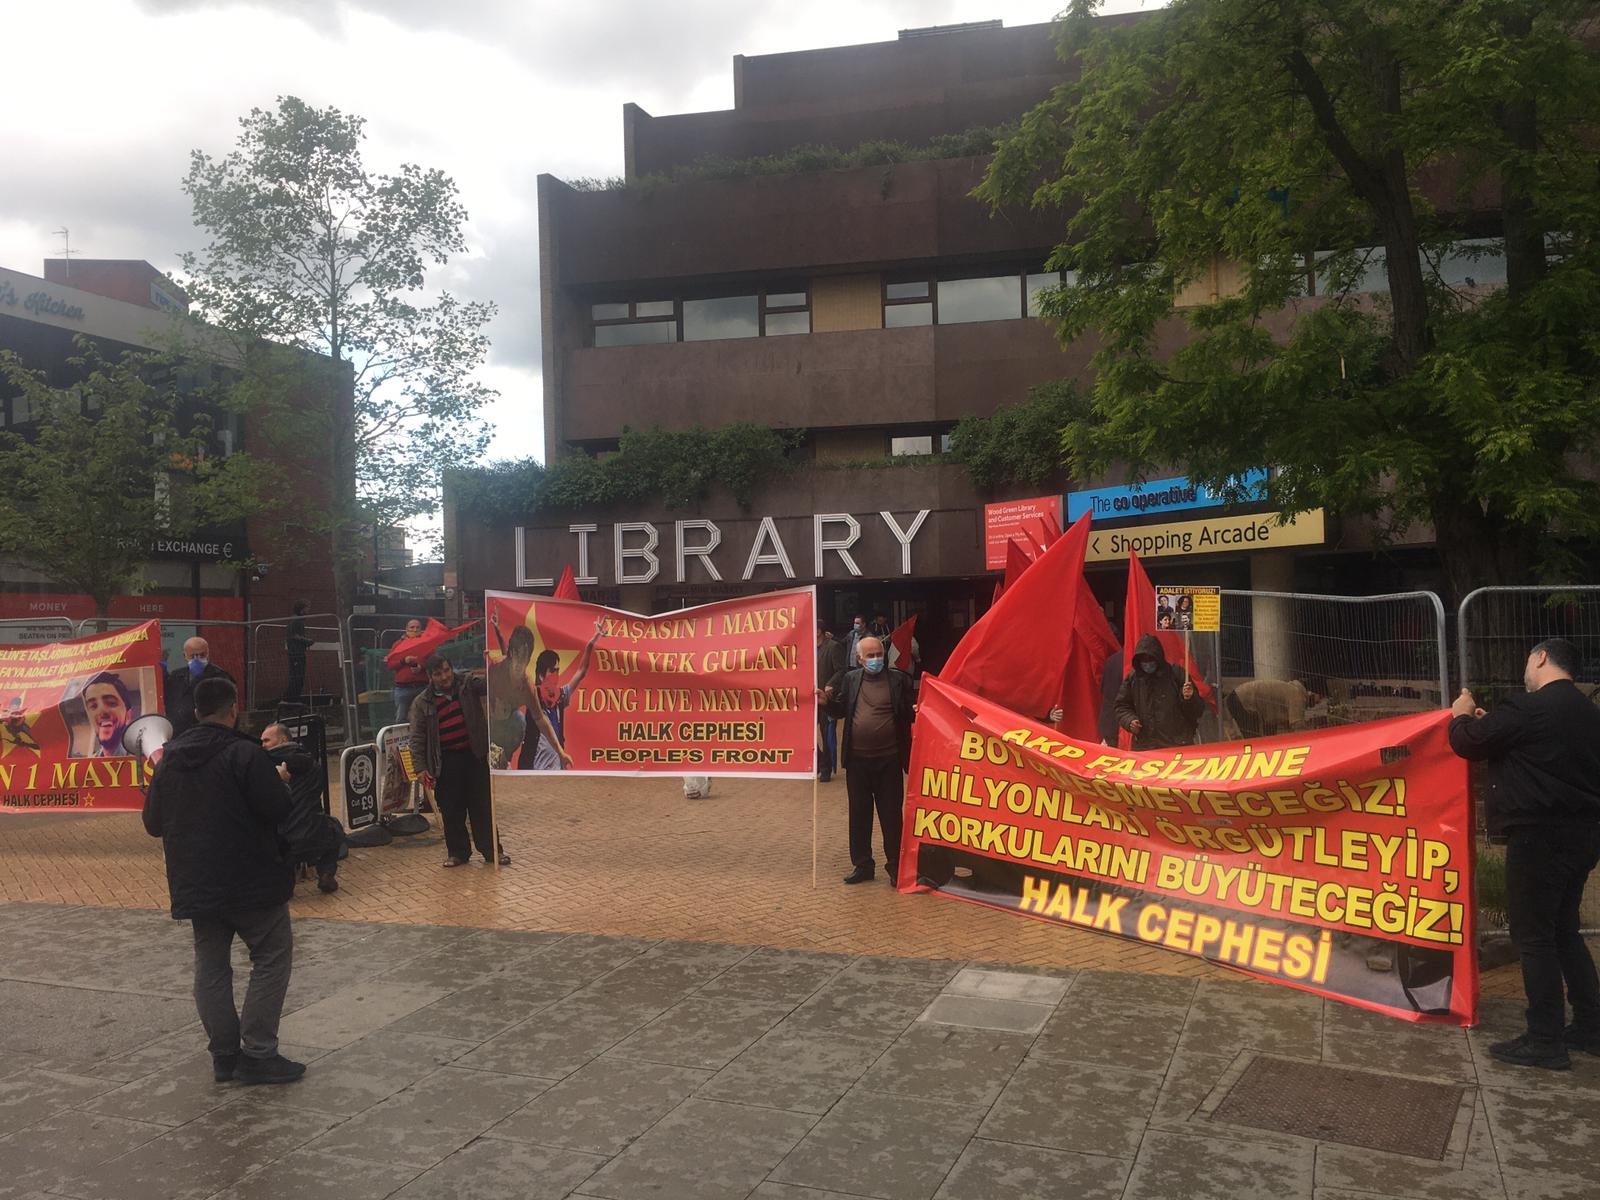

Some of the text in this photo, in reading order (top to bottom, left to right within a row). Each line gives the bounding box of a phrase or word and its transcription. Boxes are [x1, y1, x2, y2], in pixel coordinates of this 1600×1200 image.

[998, 514, 1022, 522] Customer
[1022, 511, 1045, 520] Services
[1018, 504, 1037, 512] Library
[1091, 495, 1111, 513] The
[157, 540, 220, 555] EXCHANGE
[514, 509, 931, 588] LIBRARY
[1111, 521, 1270, 554] Shopping Arcade
[30, 602, 68, 611] MONEY
[139, 604, 164, 612] HERE
[605, 606, 797, 643] YAŞASIN 1 MAYIS!
[648, 651, 696, 673] YEK
[703, 644, 798, 673] GULAN!
[577, 687, 799, 713] LONG LIVE MAY DAY!
[618, 717, 765, 742] HALK CEPHESİ
[711, 748, 794, 763] FRONT
[1002, 728, 1311, 780] AKP FAŞİZMİNE
[24, 763, 38, 790] 1
[50, 759, 154, 790] MAYIS
[3, 792, 79, 807] HALK CEPHESİ
[361, 794, 374, 811] £9
[1154, 816, 1460, 893] ÖRGÜTLEYİP,
[913, 808, 1464, 945] KORKULARINI BÜYÜTECEĞİZ!
[1018, 874, 1334, 985] HALK CEPHESİ
